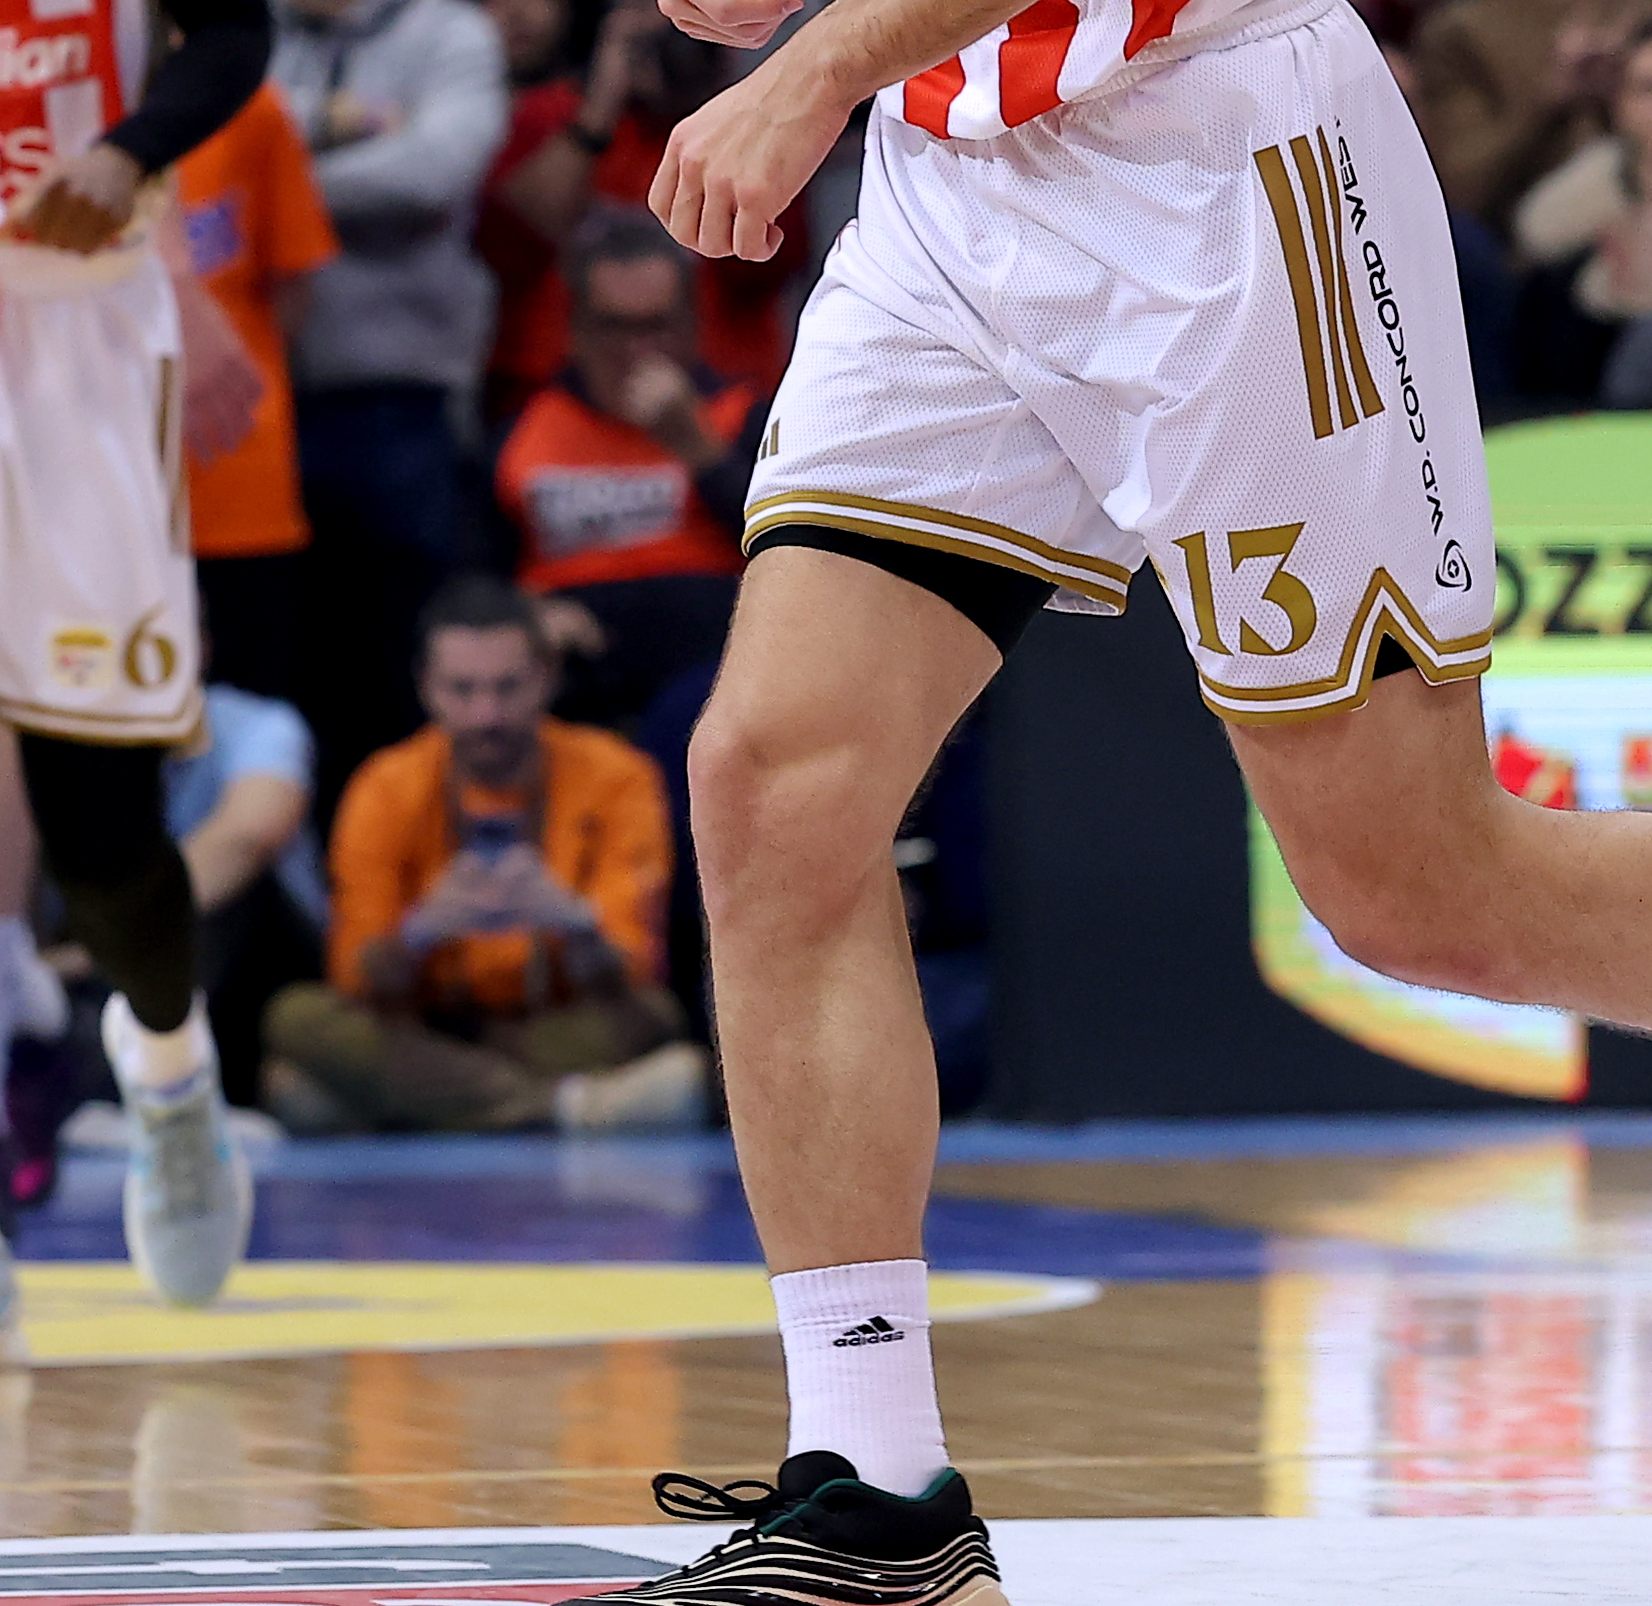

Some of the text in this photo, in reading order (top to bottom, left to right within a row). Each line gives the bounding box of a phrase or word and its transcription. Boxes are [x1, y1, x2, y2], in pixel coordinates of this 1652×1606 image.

[1334, 115, 1367, 235] WES
[1362, 240, 1427, 443] CONCORD
[123, 601, 177, 687] 6
[1172, 521, 1317, 656] 13
[832, 1330, 905, 1347] adidas
